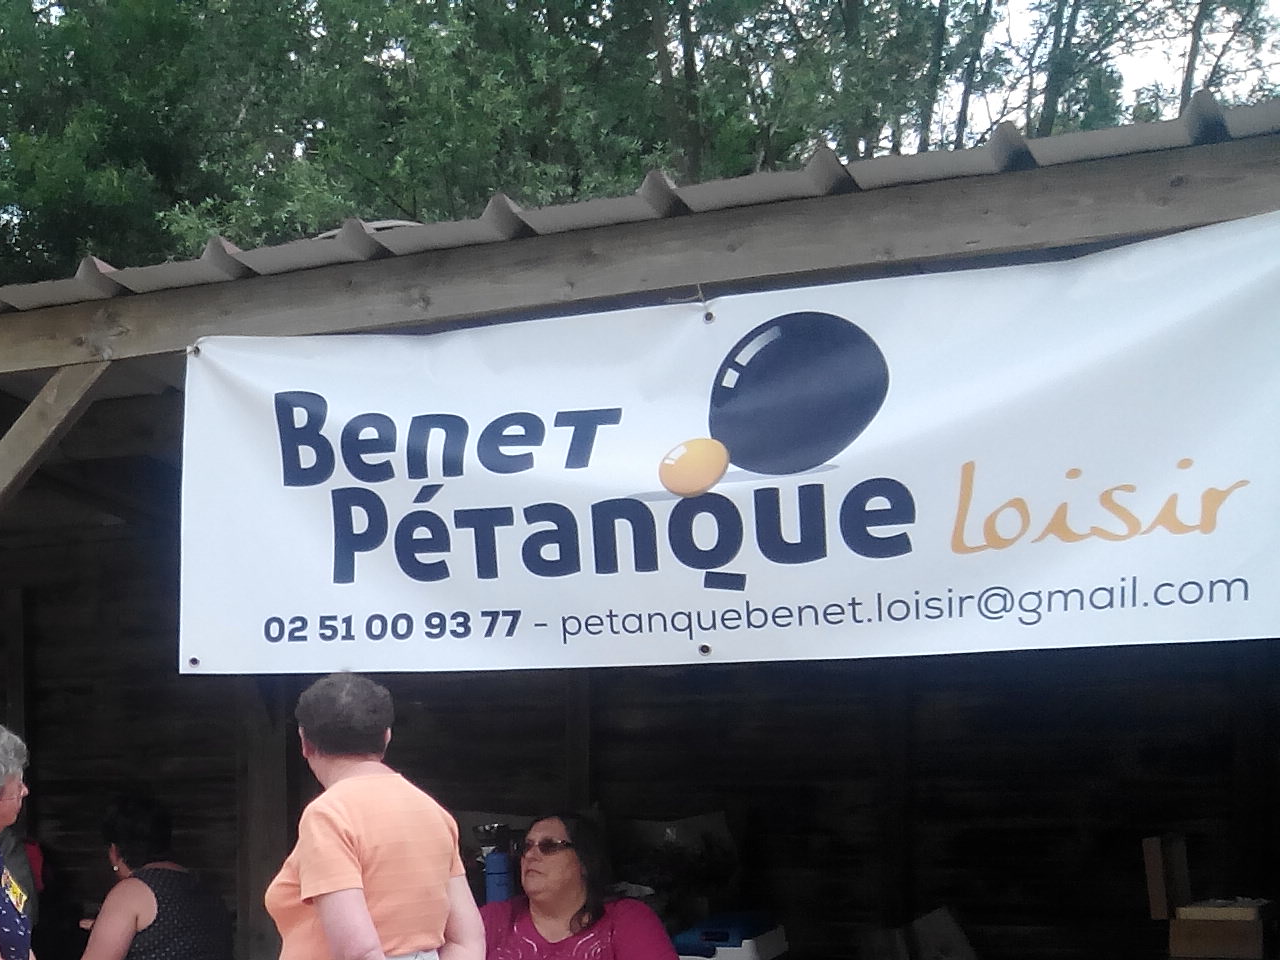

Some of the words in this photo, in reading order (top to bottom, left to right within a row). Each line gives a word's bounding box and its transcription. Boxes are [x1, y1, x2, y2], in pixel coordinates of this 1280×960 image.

[263, 615, 308, 643] 02
[318, 614, 354, 642] 51
[365, 612, 414, 641] 00
[424, 610, 472, 640] 93
[480, 609, 522, 638] 77
[561, 575, 1250, 645] petanquebenet.loisir@gmail.com
